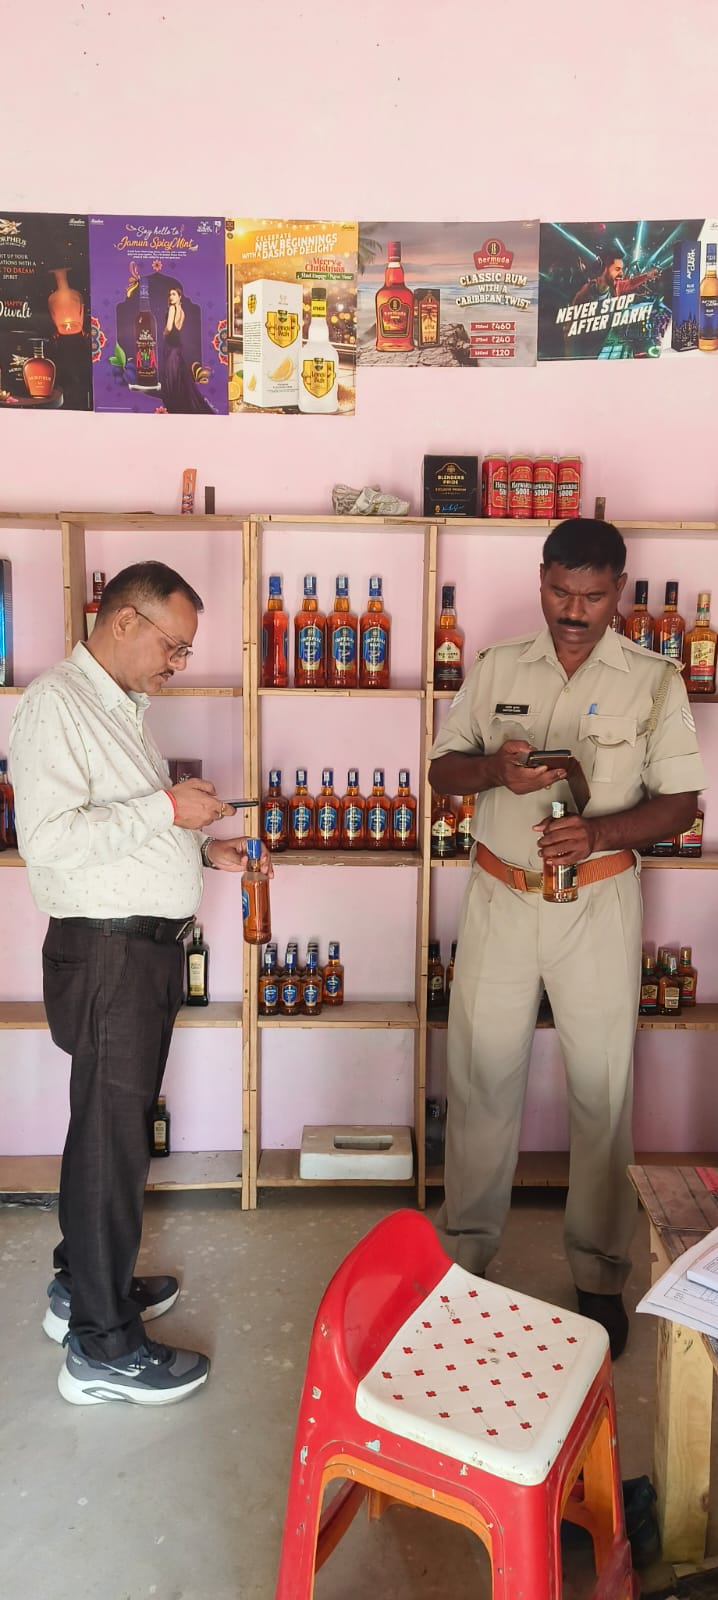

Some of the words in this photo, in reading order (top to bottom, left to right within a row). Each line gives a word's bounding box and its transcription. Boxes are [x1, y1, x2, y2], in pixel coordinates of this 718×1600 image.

[136, 226, 151, 240] Say
[154, 225, 170, 236] hello
[256, 232, 291, 242] CELEBRATE
[117, 235, 148, 250] Jamun
[150, 236, 172, 250] Spicy
[171, 236, 193, 249] Mint
[255, 239, 278, 252] NEW
[280, 233, 338, 249] BEGINNINGS
[242, 251, 257, 259] WITH
[262, 249, 285, 259] DASH
[286, 247, 299, 256] OF
[300, 243, 334, 255] DELIGHT
[313, 257, 336, 265] Merry
[305, 264, 345, 273] Christmas
[460, 273, 502, 286] CLASSIC
[505, 274, 527, 286] RUM
[479, 284, 499, 294] WITH
[502, 286, 508, 294] A
[456, 295, 502, 307] CARIBBEAN
[505, 298, 531, 309] TWIST
[556, 305, 597, 323] NEVER
[600, 294, 635, 314] STOP
[568, 315, 608, 336] AFTER
[611, 304, 653, 327] DARK!
